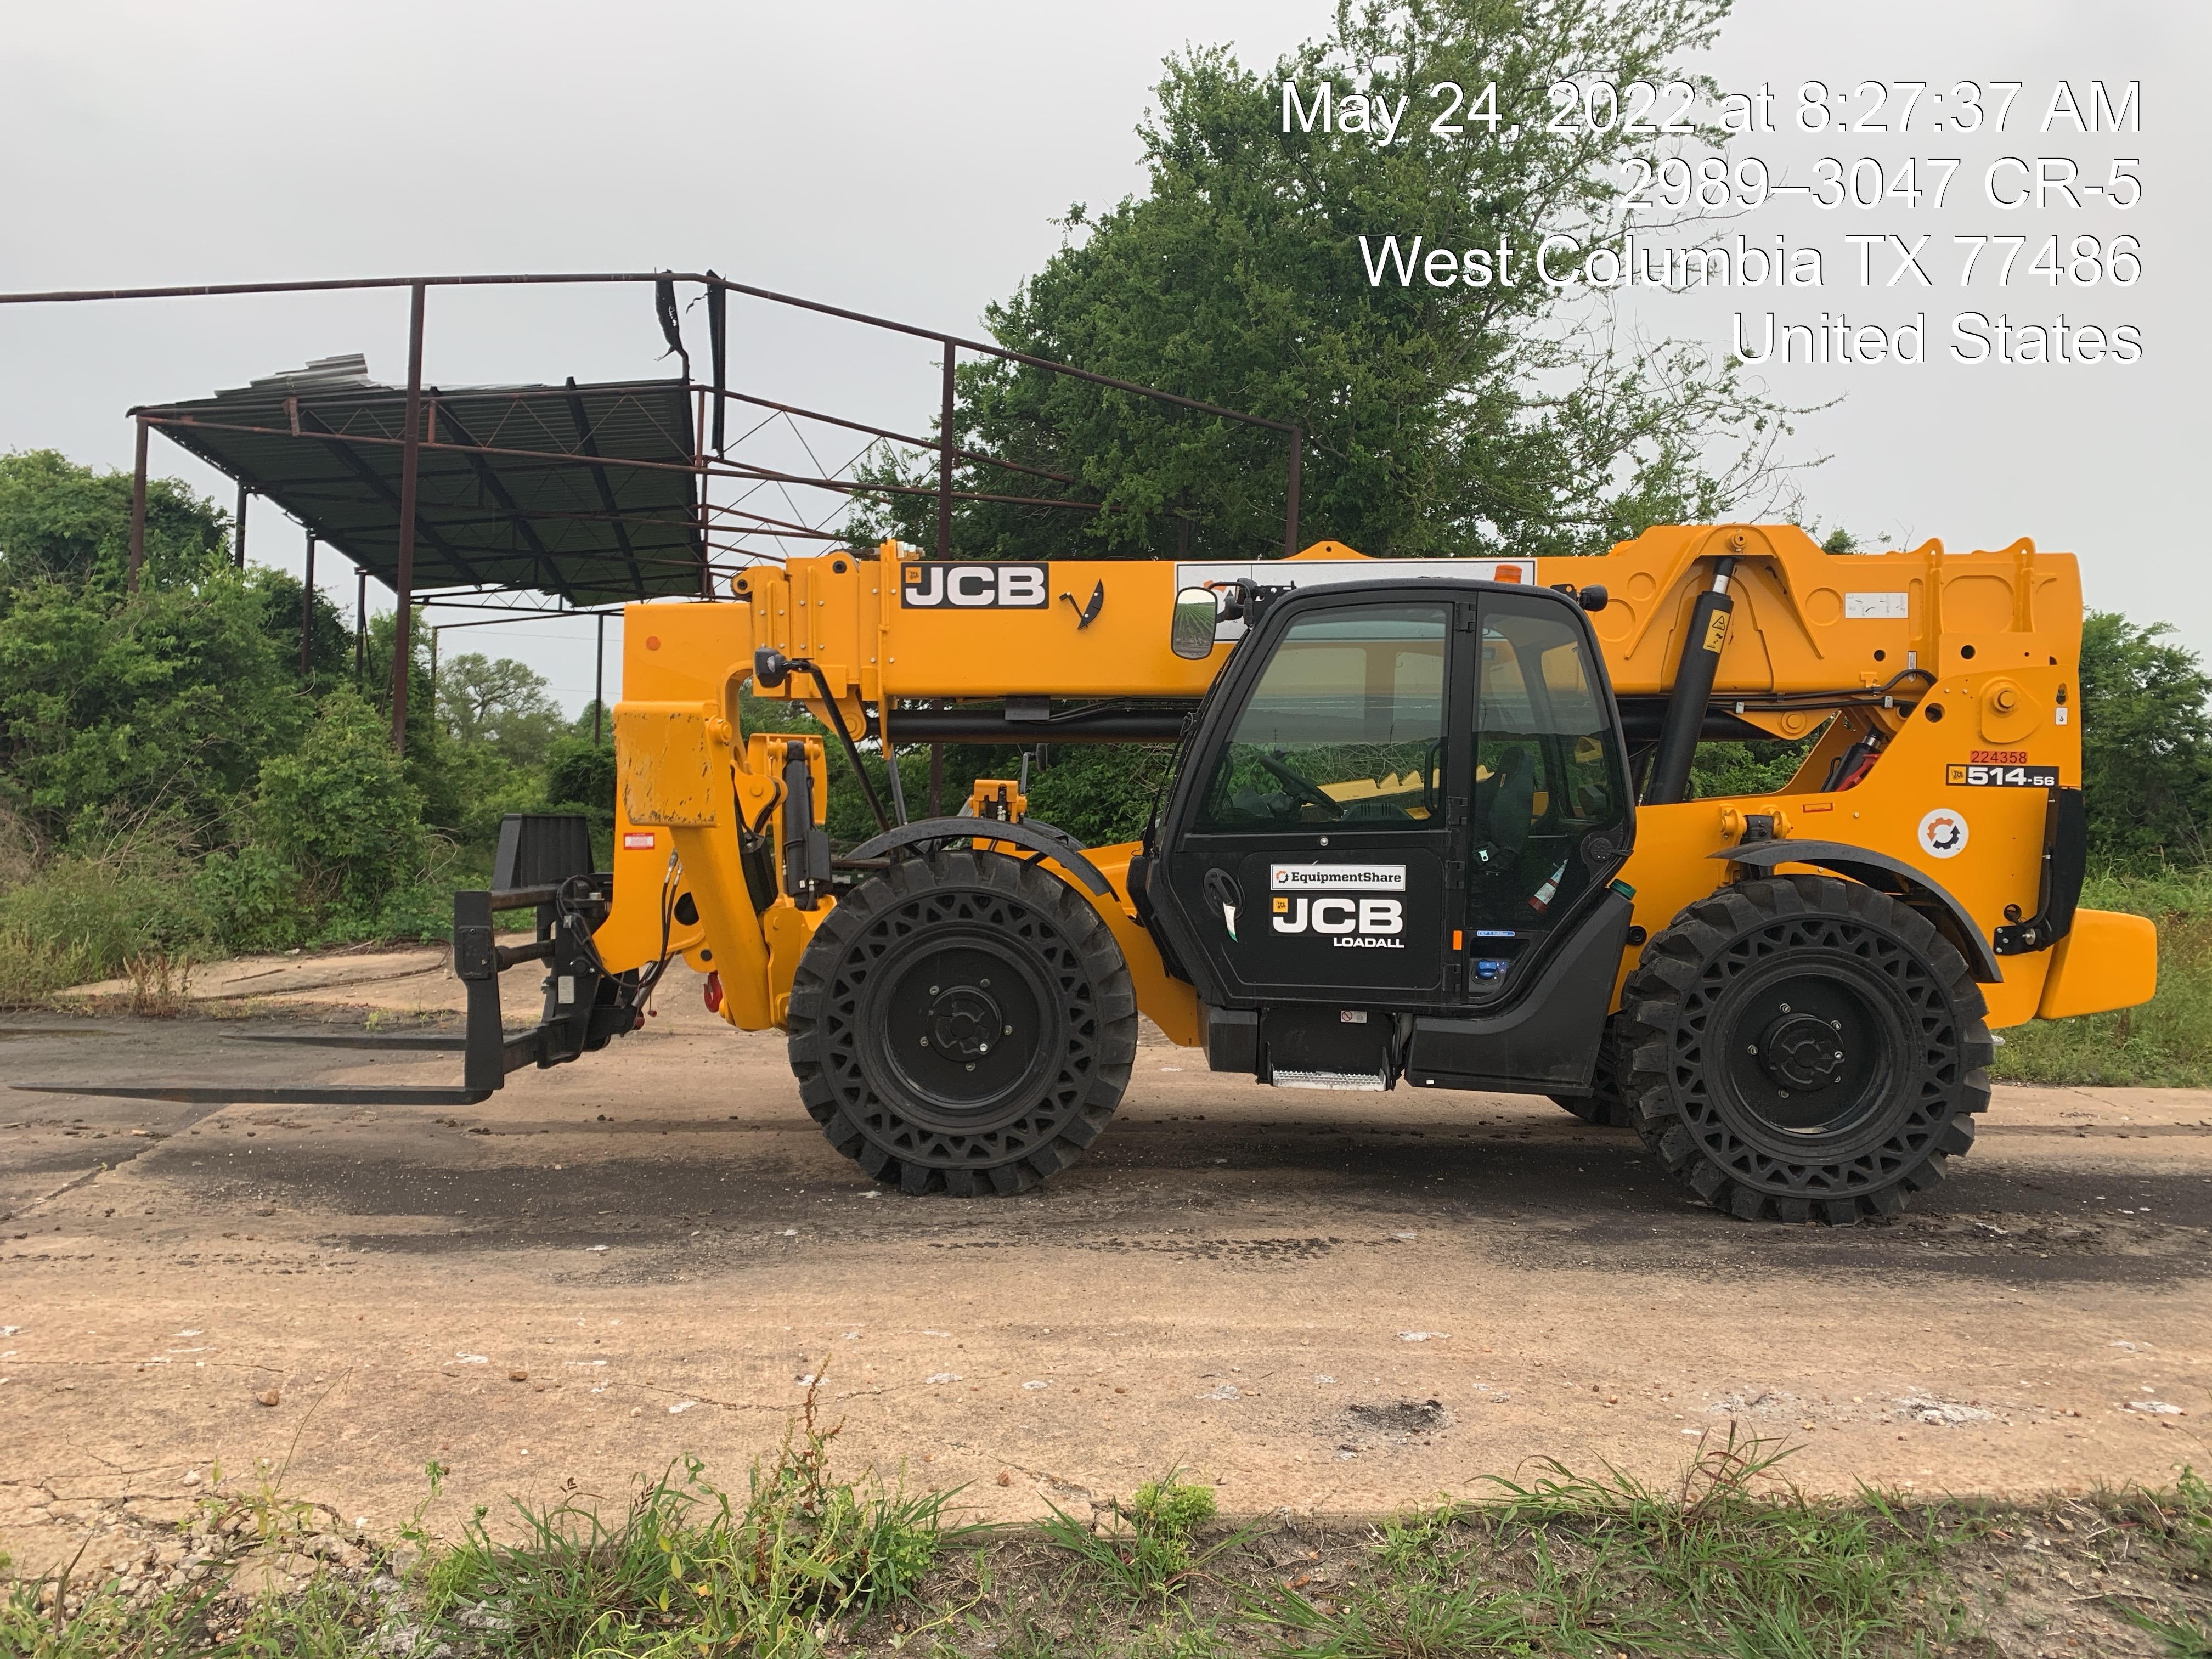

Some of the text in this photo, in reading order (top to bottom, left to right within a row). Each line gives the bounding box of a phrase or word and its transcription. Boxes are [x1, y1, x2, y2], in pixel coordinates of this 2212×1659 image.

[905, 567, 1045, 605] JCB
[1971, 751, 2027, 763] 224358
[1967, 766, 2055, 786] 514-56
[1291, 871, 1402, 884] EquipmentShare
[1273, 898, 1403, 934] JCB
[1333, 937, 1405, 949] LOADALL
